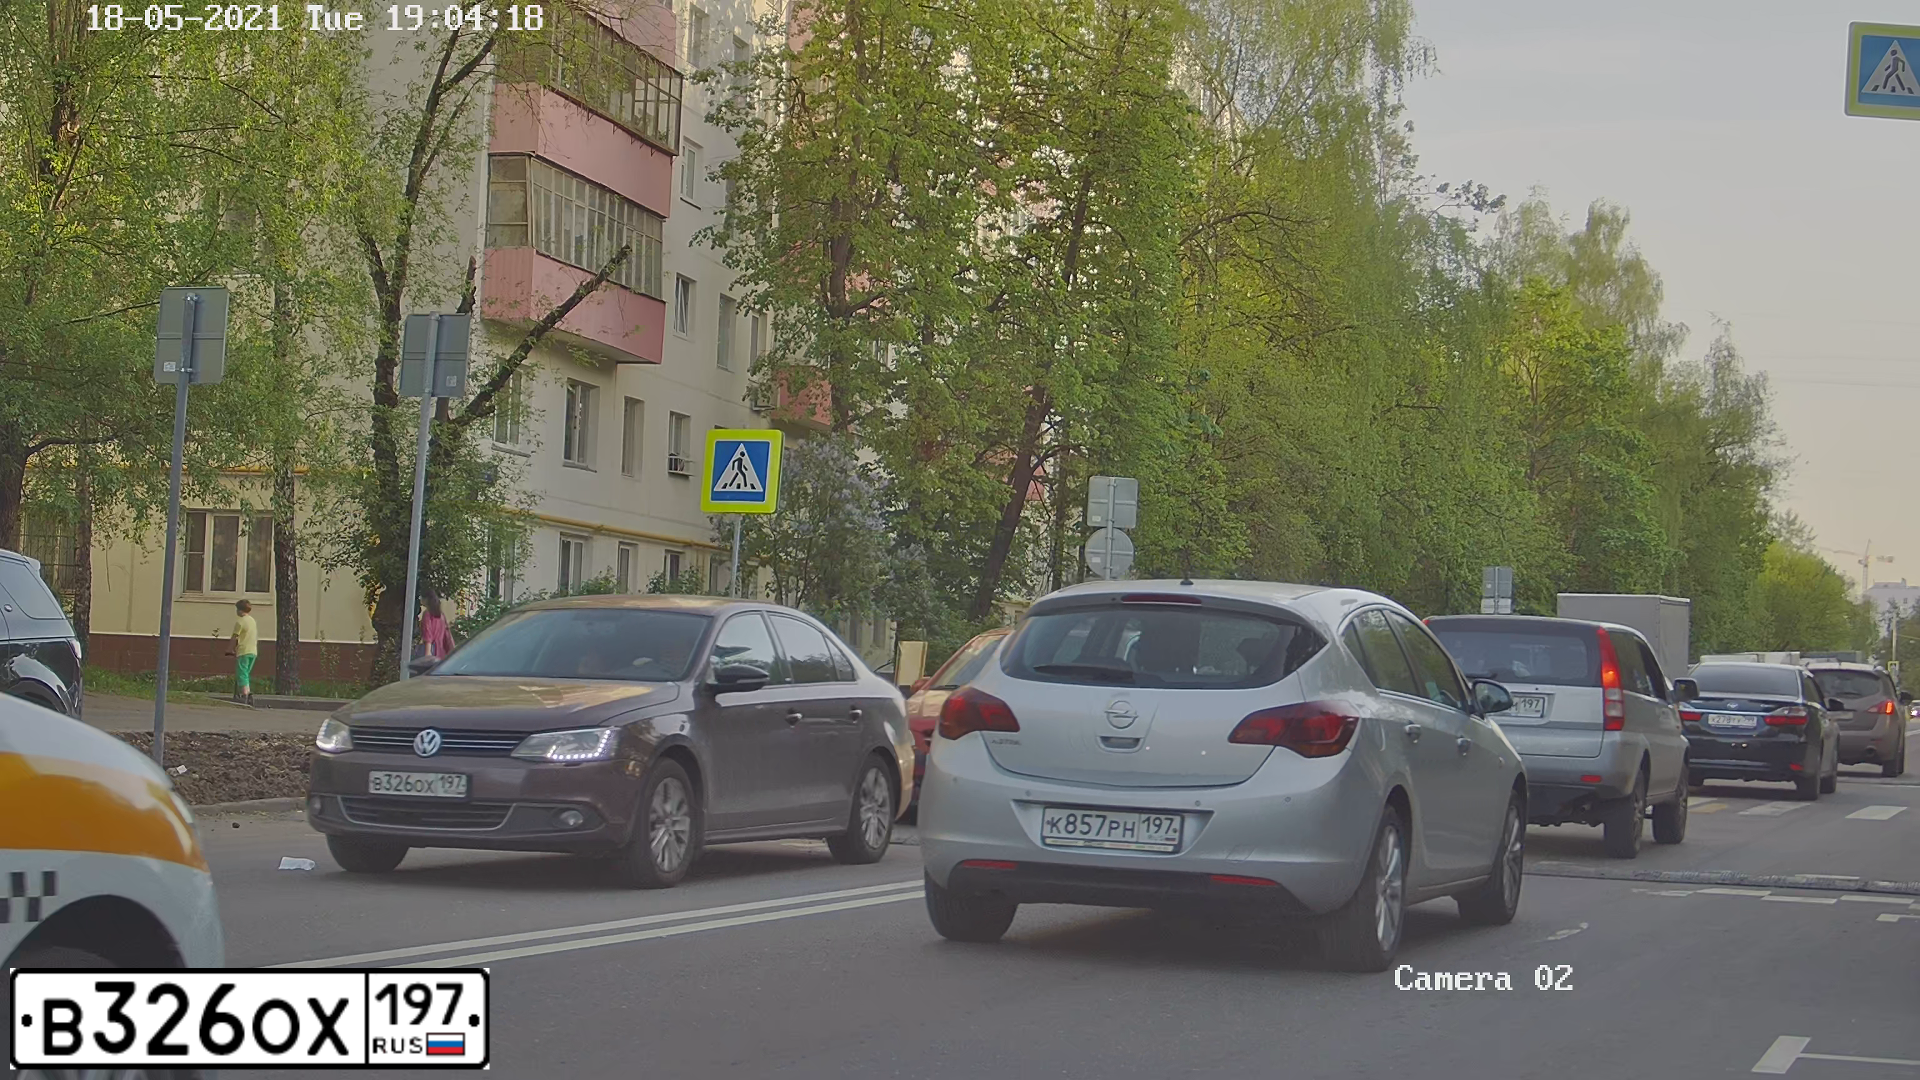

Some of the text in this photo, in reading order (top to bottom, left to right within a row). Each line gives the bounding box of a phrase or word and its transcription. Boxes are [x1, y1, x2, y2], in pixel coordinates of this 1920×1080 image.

[1521, 698, 1541, 709] 197
[373, 773, 463, 793] В326ОХ 197
[1049, 813, 1175, 839] К857РН 197
